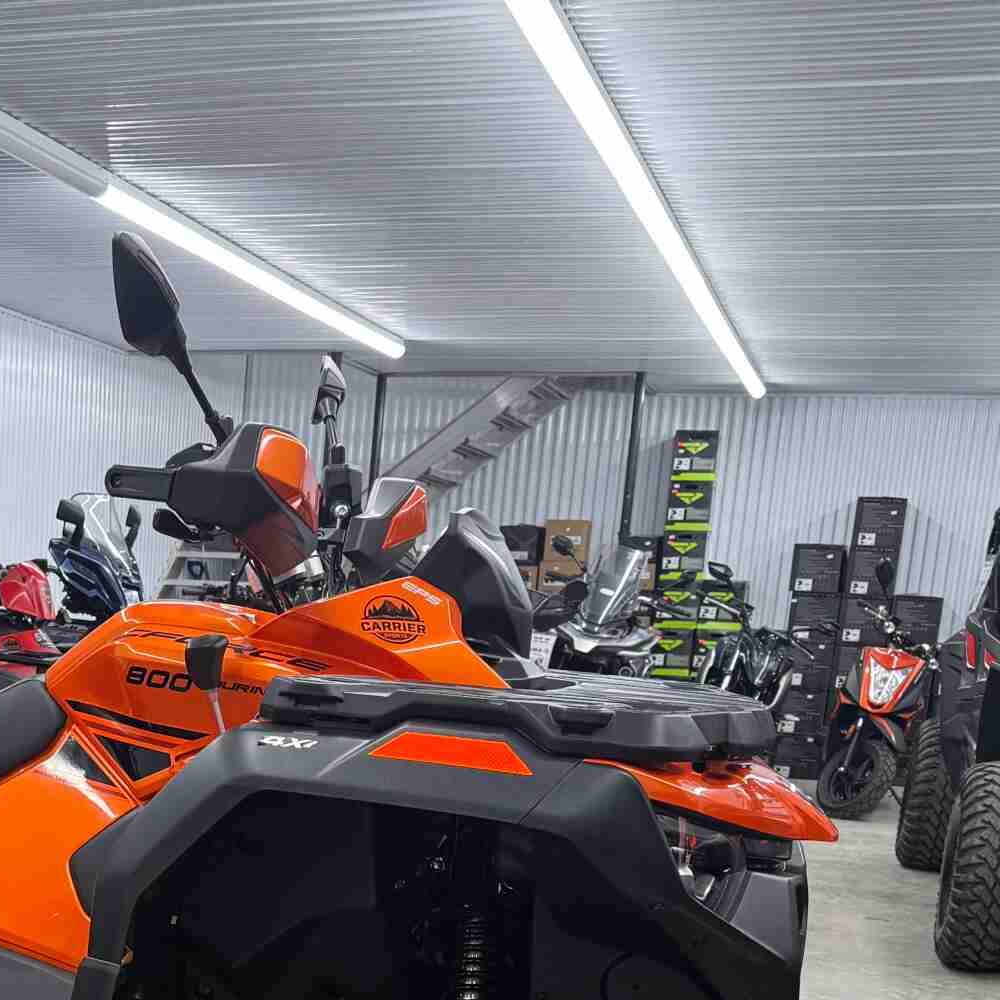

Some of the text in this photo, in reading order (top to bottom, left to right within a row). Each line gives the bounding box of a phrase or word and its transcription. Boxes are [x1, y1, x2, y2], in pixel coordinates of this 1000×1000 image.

[360, 621, 426, 634] CARRIER
[128, 629, 329, 672] CFRCE
[126, 665, 192, 693] 800
